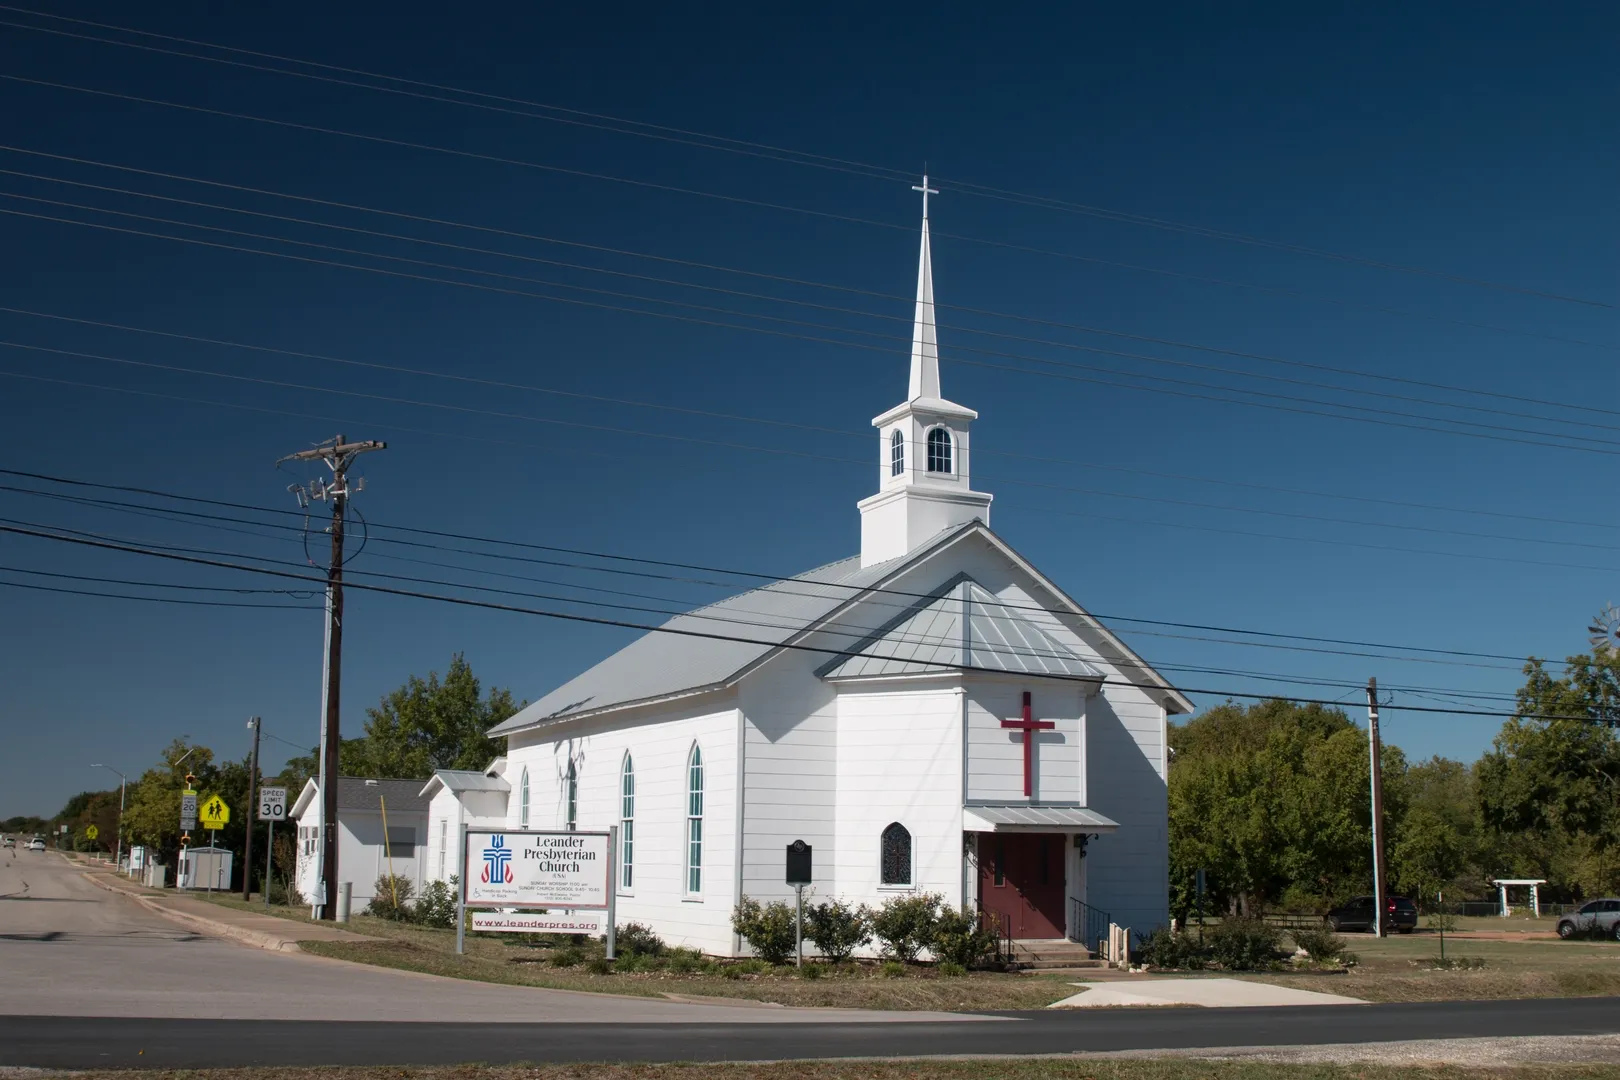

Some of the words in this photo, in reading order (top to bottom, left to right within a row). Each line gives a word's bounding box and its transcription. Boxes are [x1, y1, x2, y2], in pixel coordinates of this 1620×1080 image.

[262, 803, 283, 816] 30
[536, 836, 585, 847] Leander
[524, 848, 596, 862] Presbyterian
[539, 861, 580, 873] Church
[474, 919, 598, 931] www.leanderpres.org
